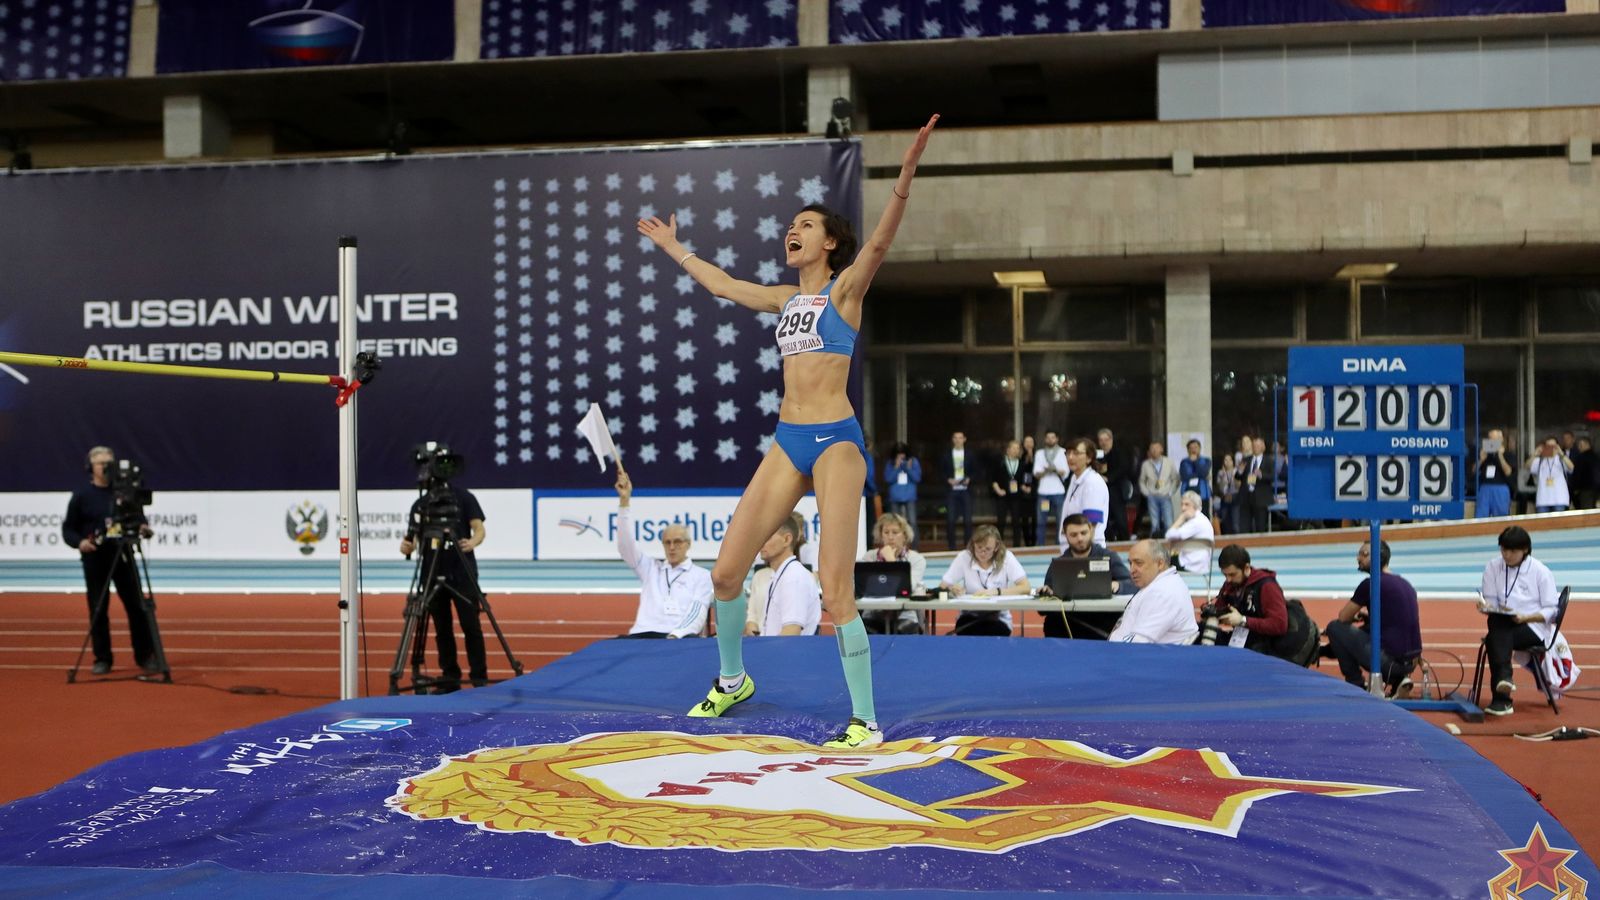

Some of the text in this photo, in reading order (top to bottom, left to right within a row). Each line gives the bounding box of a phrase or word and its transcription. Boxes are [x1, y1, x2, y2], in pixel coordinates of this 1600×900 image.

[83, 292, 458, 328] RUSSIAN WINTER
[778, 311, 816, 339] 299
[84, 342, 222, 362] ATHLETICS
[229, 340, 329, 360] INDOOR
[1343, 358, 1407, 372] DIMA
[1300, 436, 1449, 448] ESSAI DOSSARD
[1412, 504, 1442, 515] PERF
